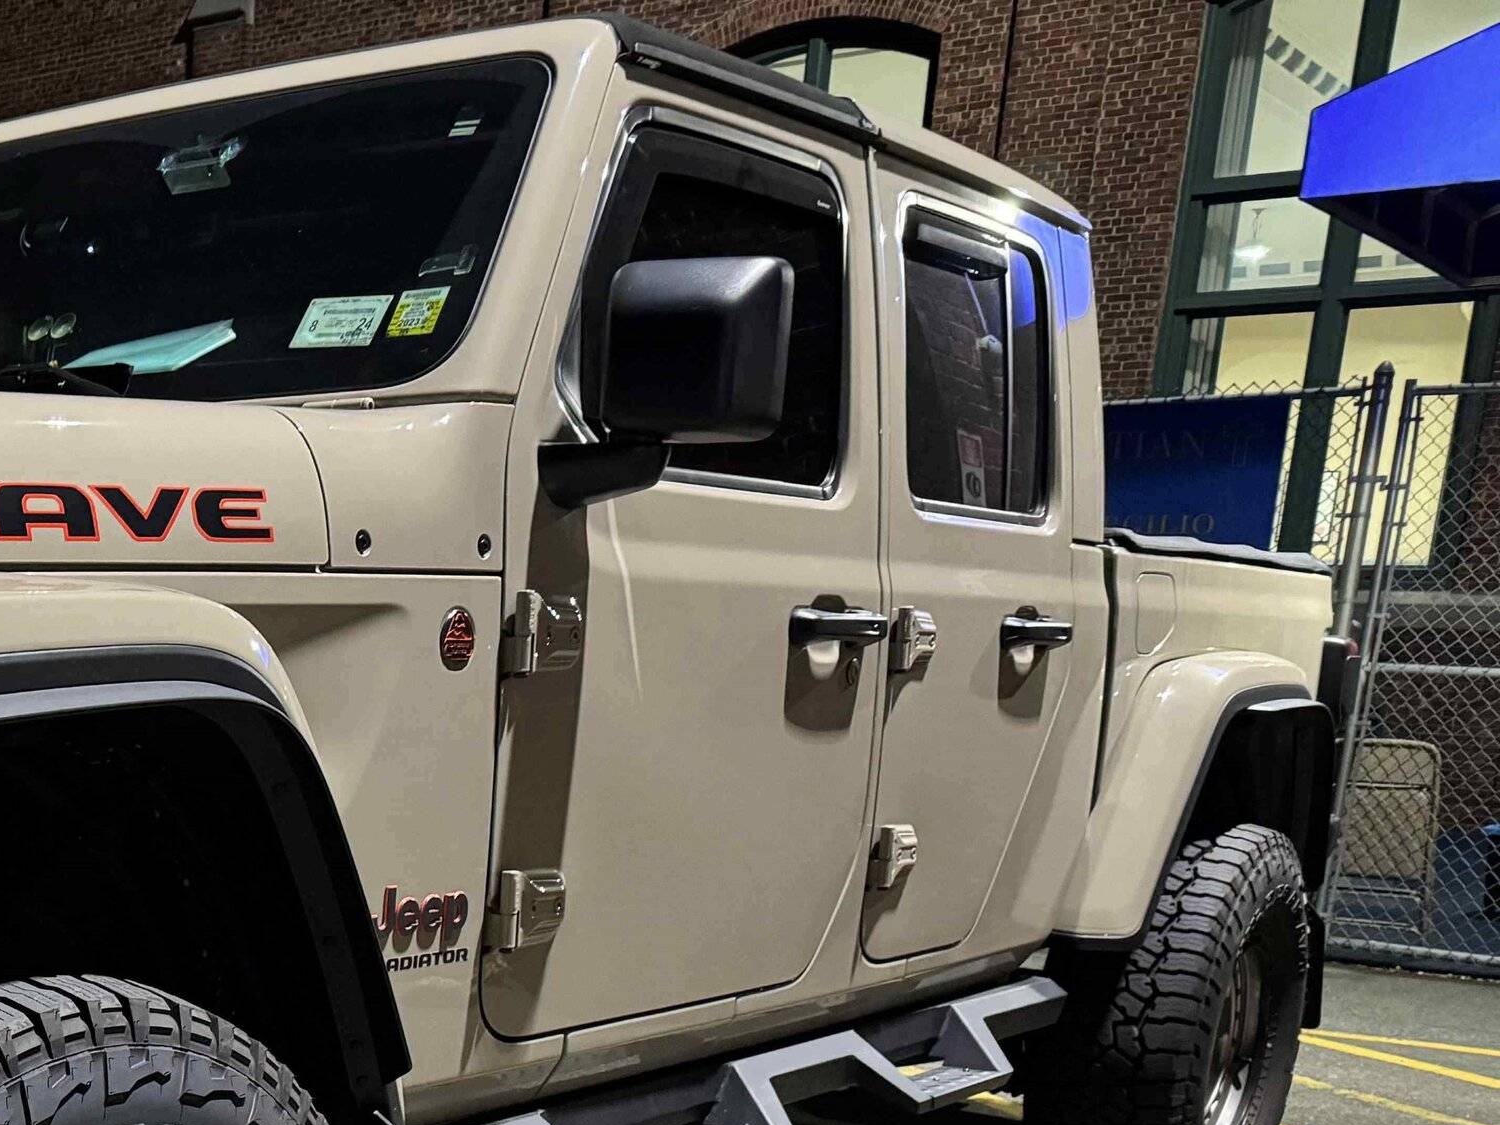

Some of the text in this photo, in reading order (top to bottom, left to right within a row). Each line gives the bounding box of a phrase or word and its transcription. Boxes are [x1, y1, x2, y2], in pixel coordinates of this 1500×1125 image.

[308, 317, 374, 333] 8 24
[1107, 430, 1206, 460] TIAN
[371, 884, 469, 951] Jeep
[386, 948, 469, 972] ADIATOR
